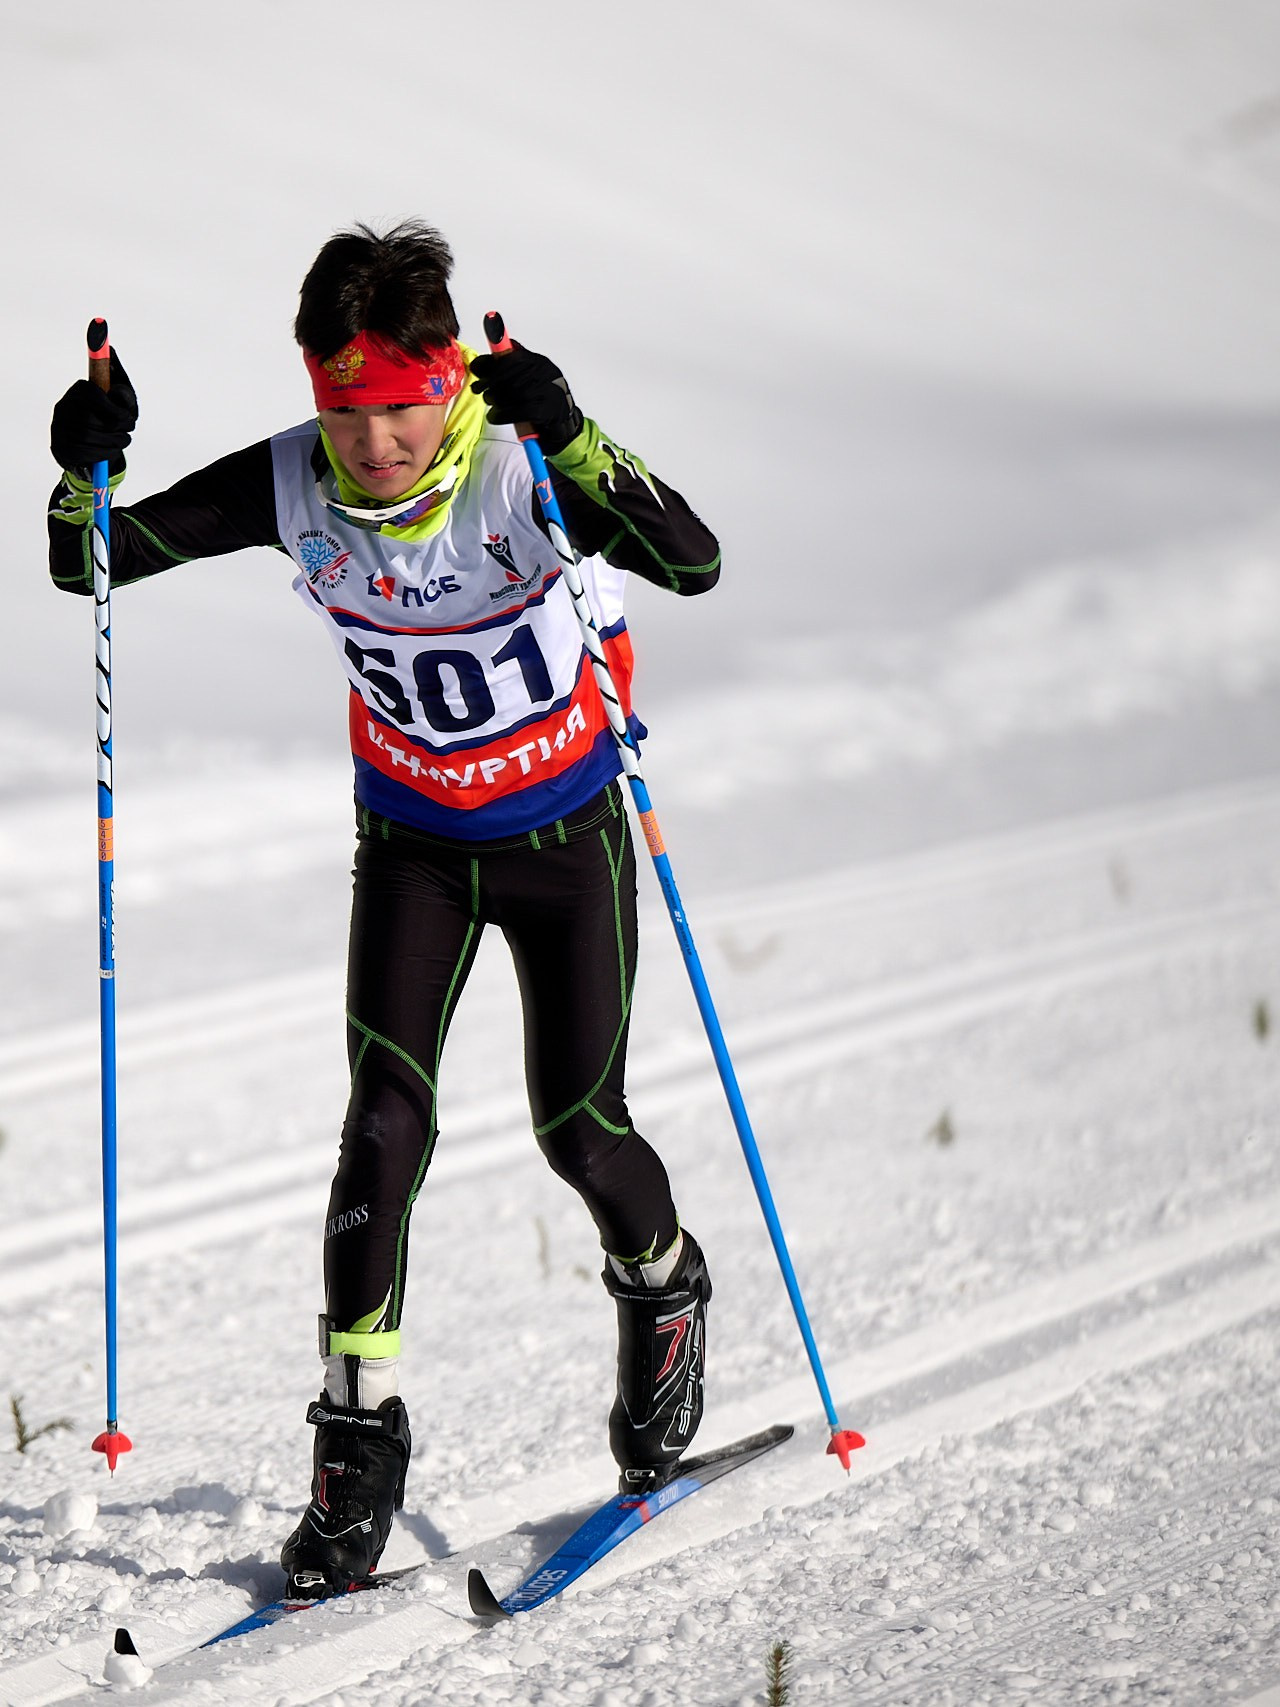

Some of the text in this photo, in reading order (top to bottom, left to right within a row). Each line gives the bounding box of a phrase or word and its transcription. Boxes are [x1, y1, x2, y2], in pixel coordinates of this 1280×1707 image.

[402, 574, 462, 608] ПСБ
[344, 623, 556, 733] 501
[678, 1319, 702, 1437] SPINE
[316, 1411, 383, 1427] SPINE
